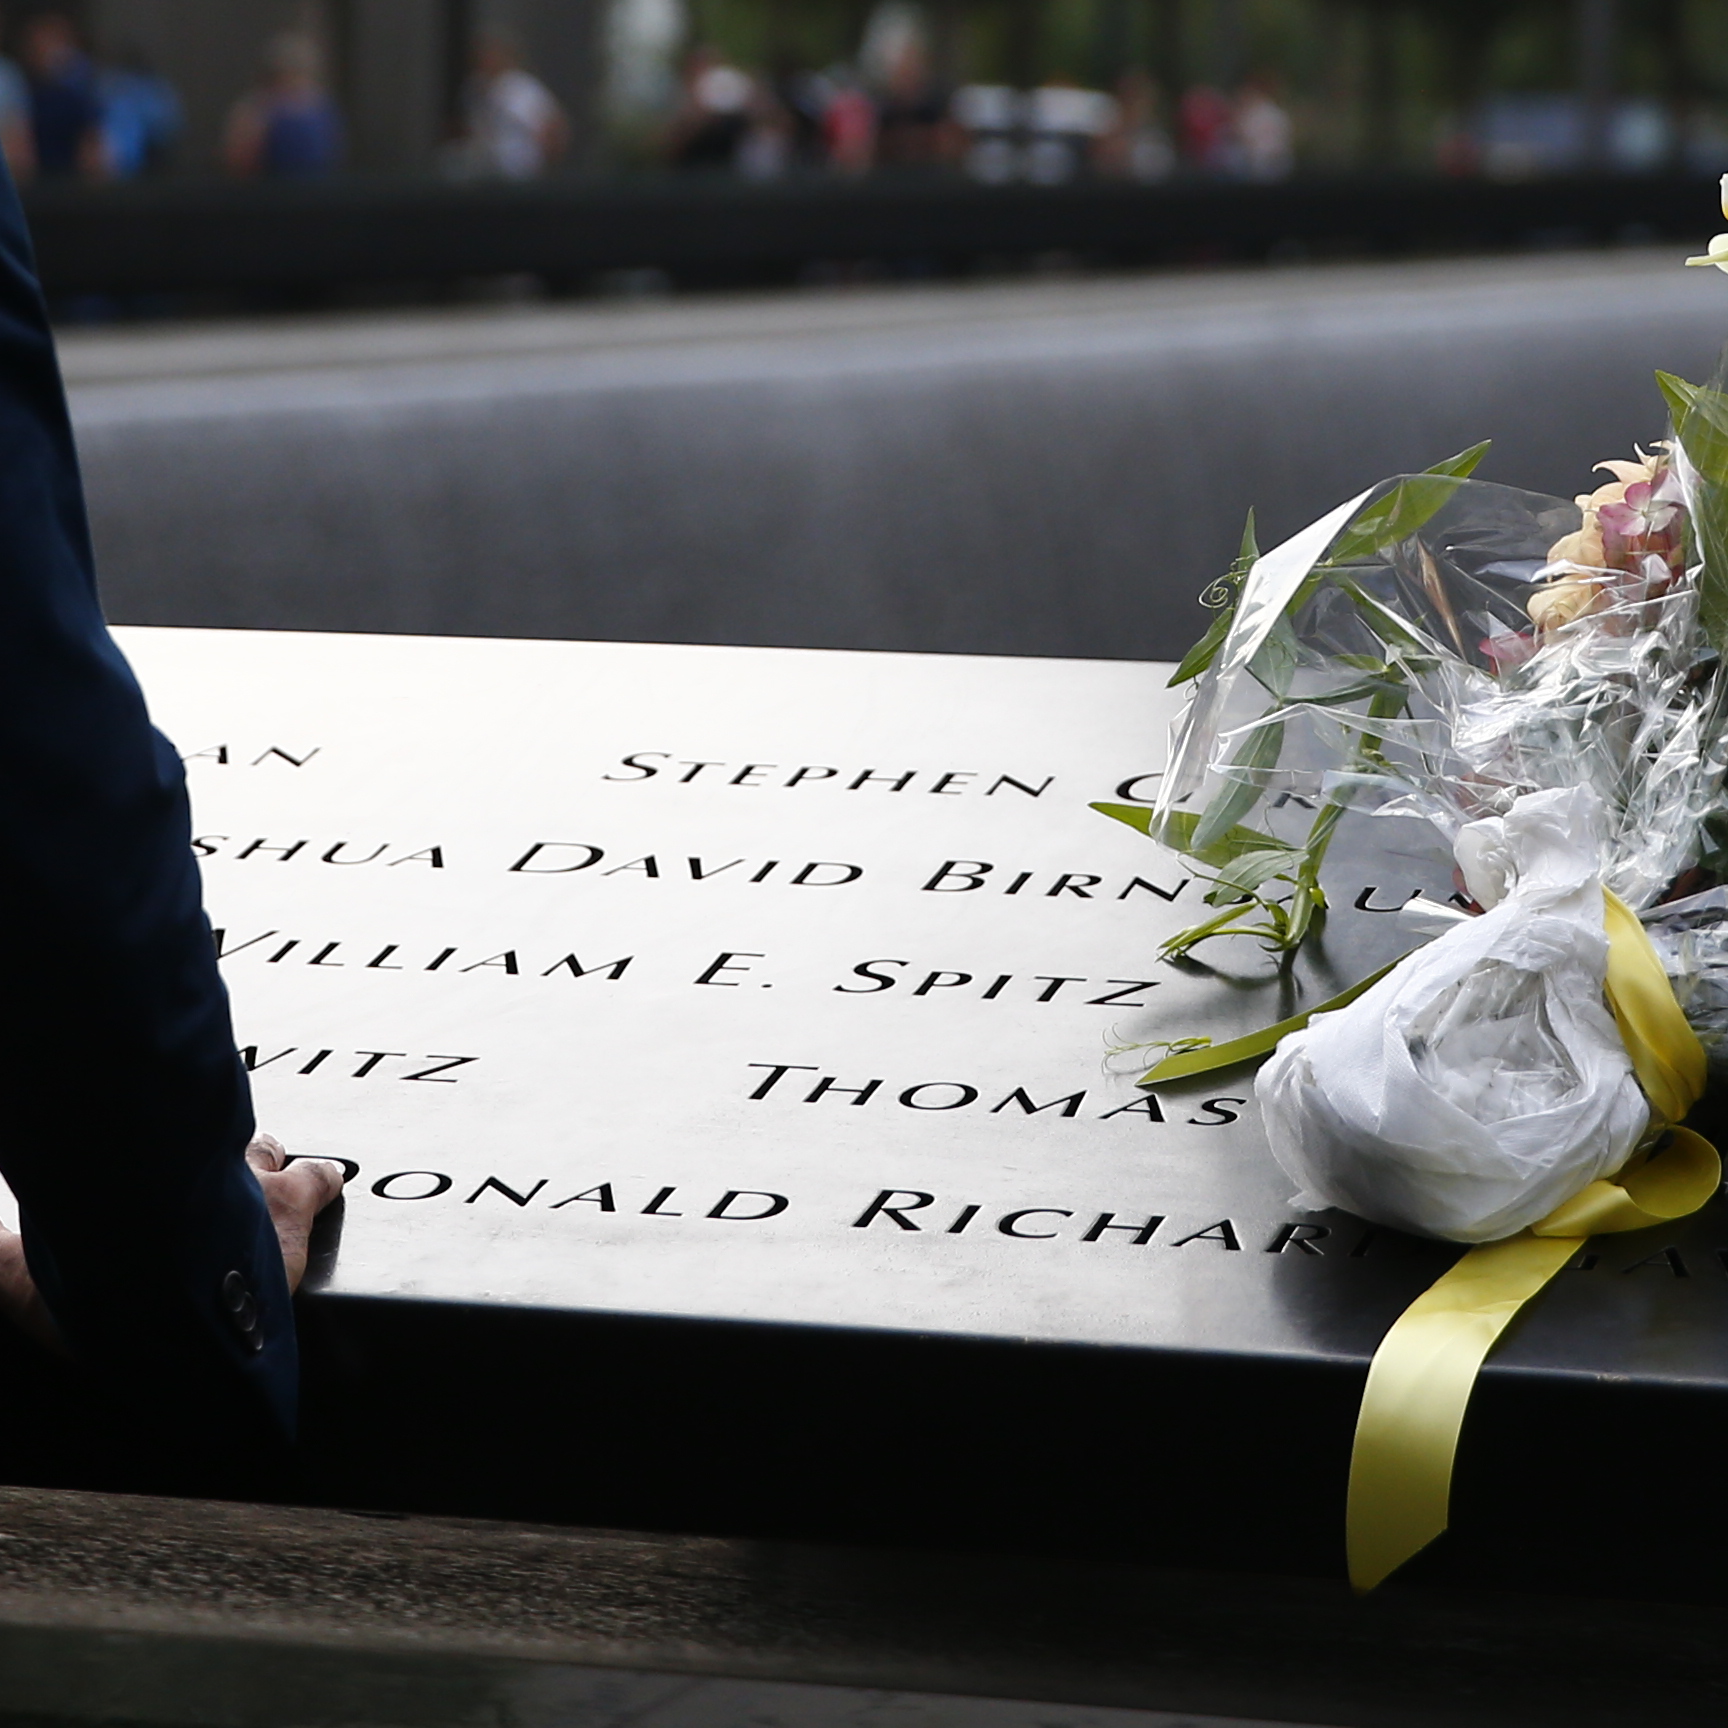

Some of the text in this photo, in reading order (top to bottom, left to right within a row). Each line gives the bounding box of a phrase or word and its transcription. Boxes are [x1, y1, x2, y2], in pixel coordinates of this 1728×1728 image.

[182, 743, 322, 768] AN
[601, 752, 1056, 797] STEPHEN
[188, 835, 447, 869] SHUA
[508, 842, 864, 886] DAVID
[694, 951, 774, 989] E.
[832, 959, 1161, 1008] SPITZ
[746, 1063, 1248, 1126] THOMAS
